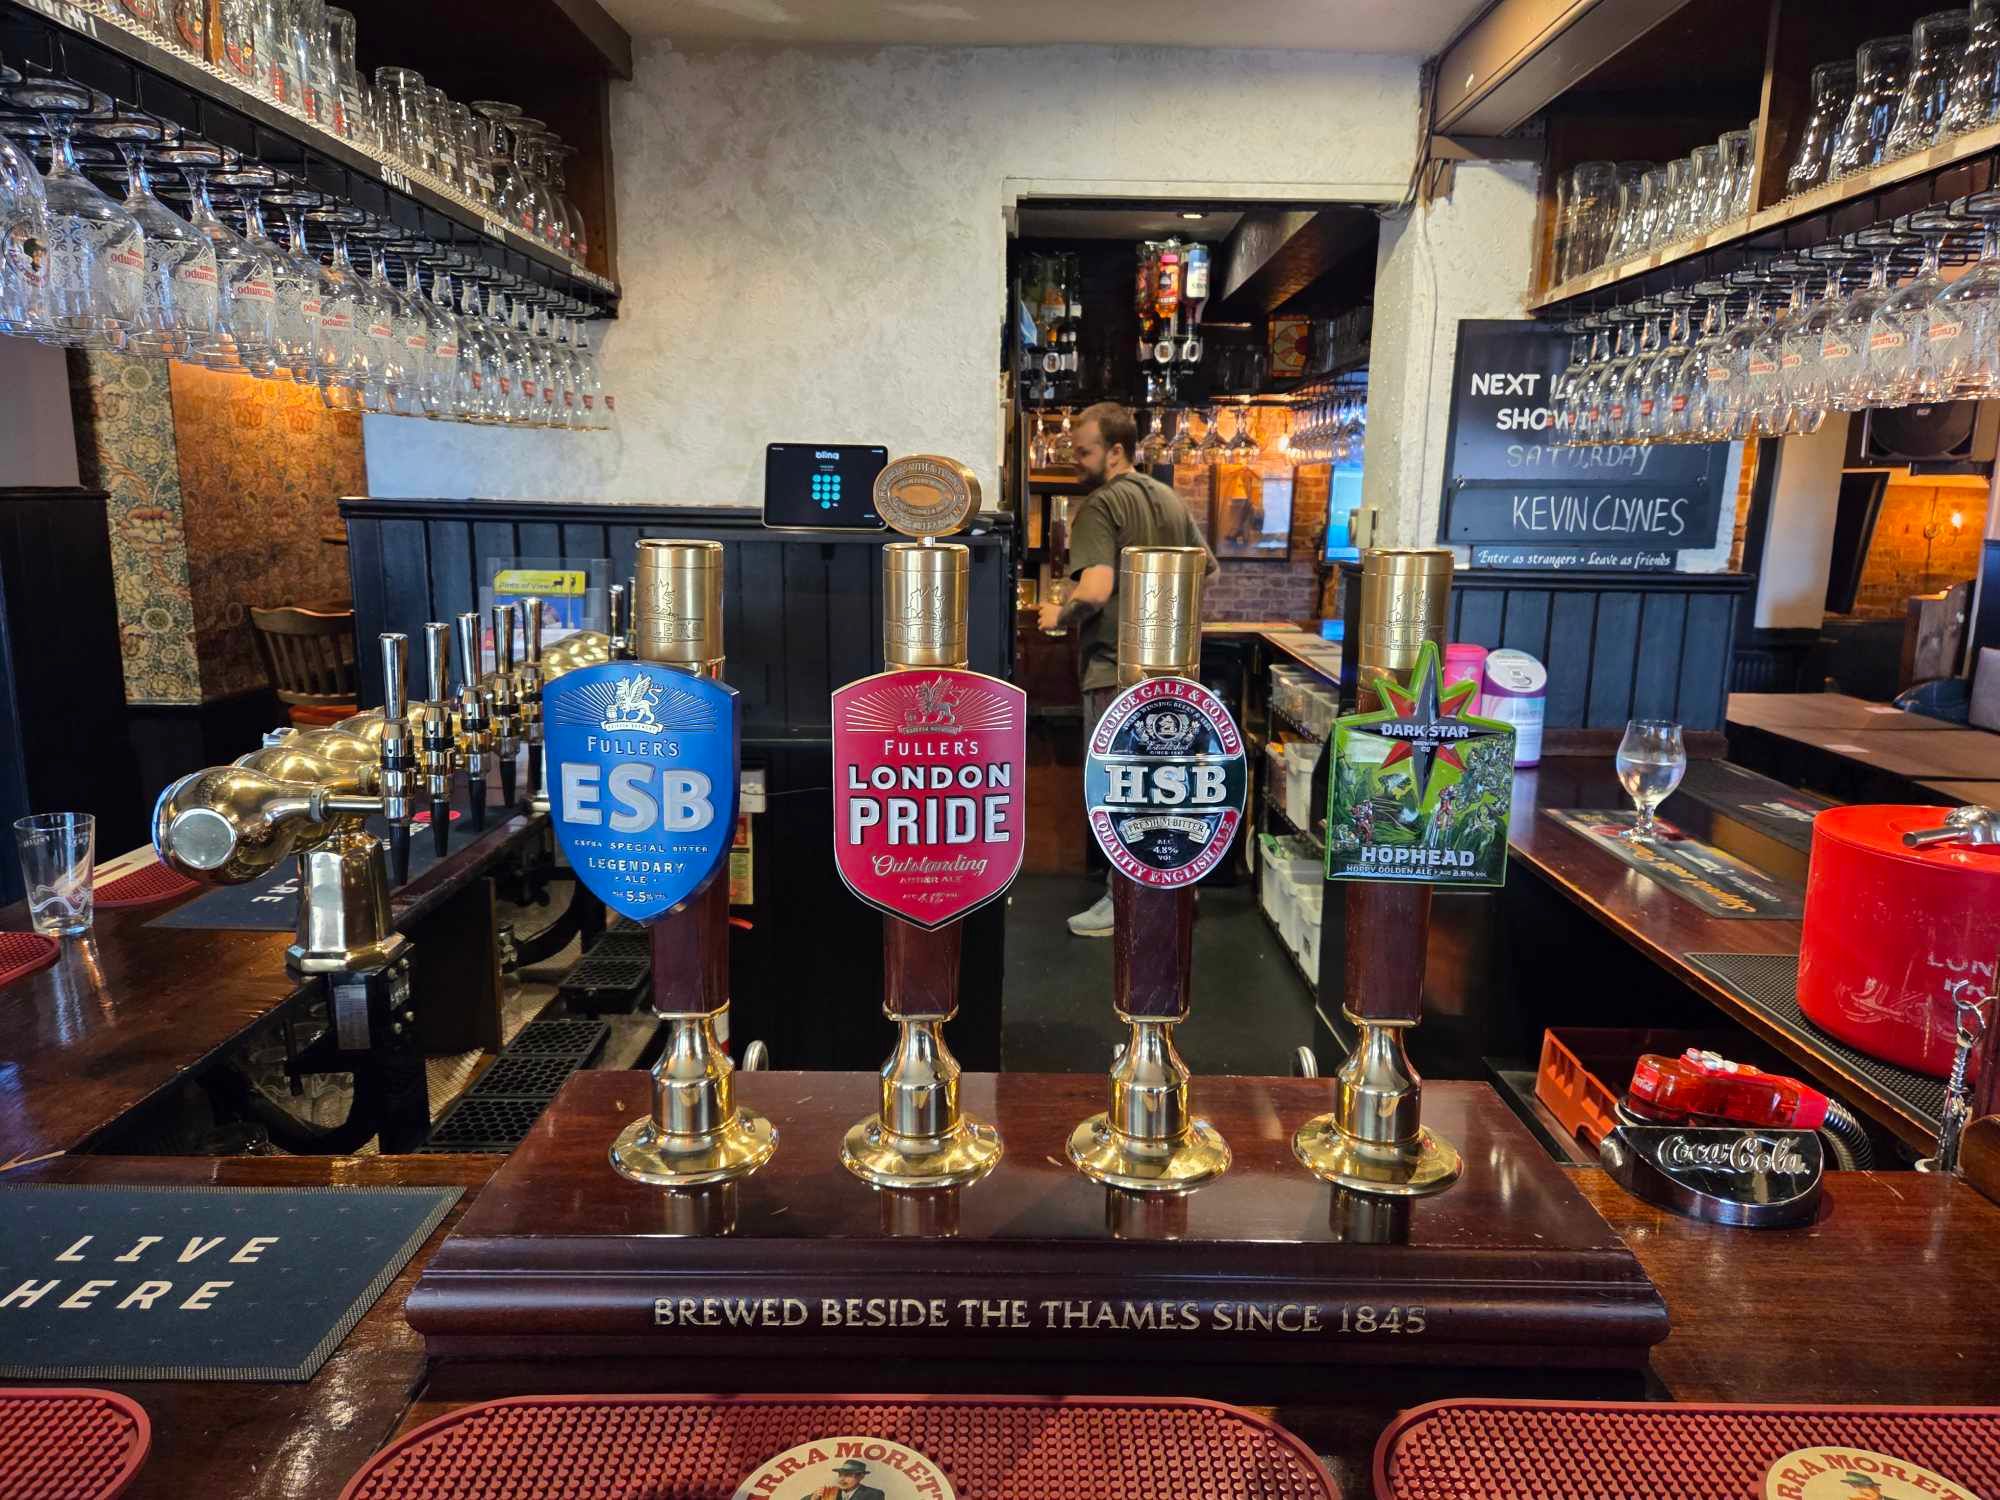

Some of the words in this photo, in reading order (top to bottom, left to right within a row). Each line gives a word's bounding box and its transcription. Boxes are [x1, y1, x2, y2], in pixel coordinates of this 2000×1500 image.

[1470, 373, 1541, 396] NEXT
[1507, 445, 1653, 475] SATURDAY
[1513, 496, 1590, 533] KEVIN
[1591, 495, 1689, 536] CLYNES
[1478, 551, 1509, 564] Enter
[1513, 555, 1524, 564] as
[1527, 552, 1576, 569] strangers
[1588, 553, 1617, 566] Leave
[1620, 556, 1632, 566] as
[1634, 551, 1671, 569] friends
[1097, 694, 1140, 748] GEORGE
[1141, 682, 1185, 698] GALE
[1188, 688, 1200, 702] &
[1218, 718, 1237, 748] LTD
[1381, 723, 1425, 737] DARK
[1428, 724, 1469, 738] STAR
[587, 735, 680, 757] FULLER'S
[884, 738, 978, 757] FULLER'S
[849, 762, 1011, 790] LONDON
[1104, 764, 1227, 805] HSB
[561, 762, 714, 834] ESB
[849, 795, 1010, 845] PRIDE
[1170, 817, 1206, 833] BITTER
[610, 842, 665, 853] SPECIAL
[1097, 820, 1148, 880] QUALITY
[1150, 850, 1218, 884] ENGLISH
[1152, 846, 1179, 854] 4.8%
[1361, 847, 1475, 867] HOPHEAD
[588, 857, 685, 873] LEGENDARY
[872, 854, 988, 877] Outstanding
[1378, 866, 1414, 875] GOLDEN
[1415, 867, 1432, 876] ALE
[625, 875, 647, 884] ALE
[54, 1235, 280, 1263] LIVE
[0, 1279, 235, 1310] HERE
[654, 1297, 809, 1327] BREWED
[821, 1298, 950, 1327] BESIDE
[957, 1298, 1032, 1328] THE
[1040, 1299, 1200, 1331] THAMES
[1211, 1302, 1324, 1333] SINCE
[1337, 1302, 1428, 1334] 1845
